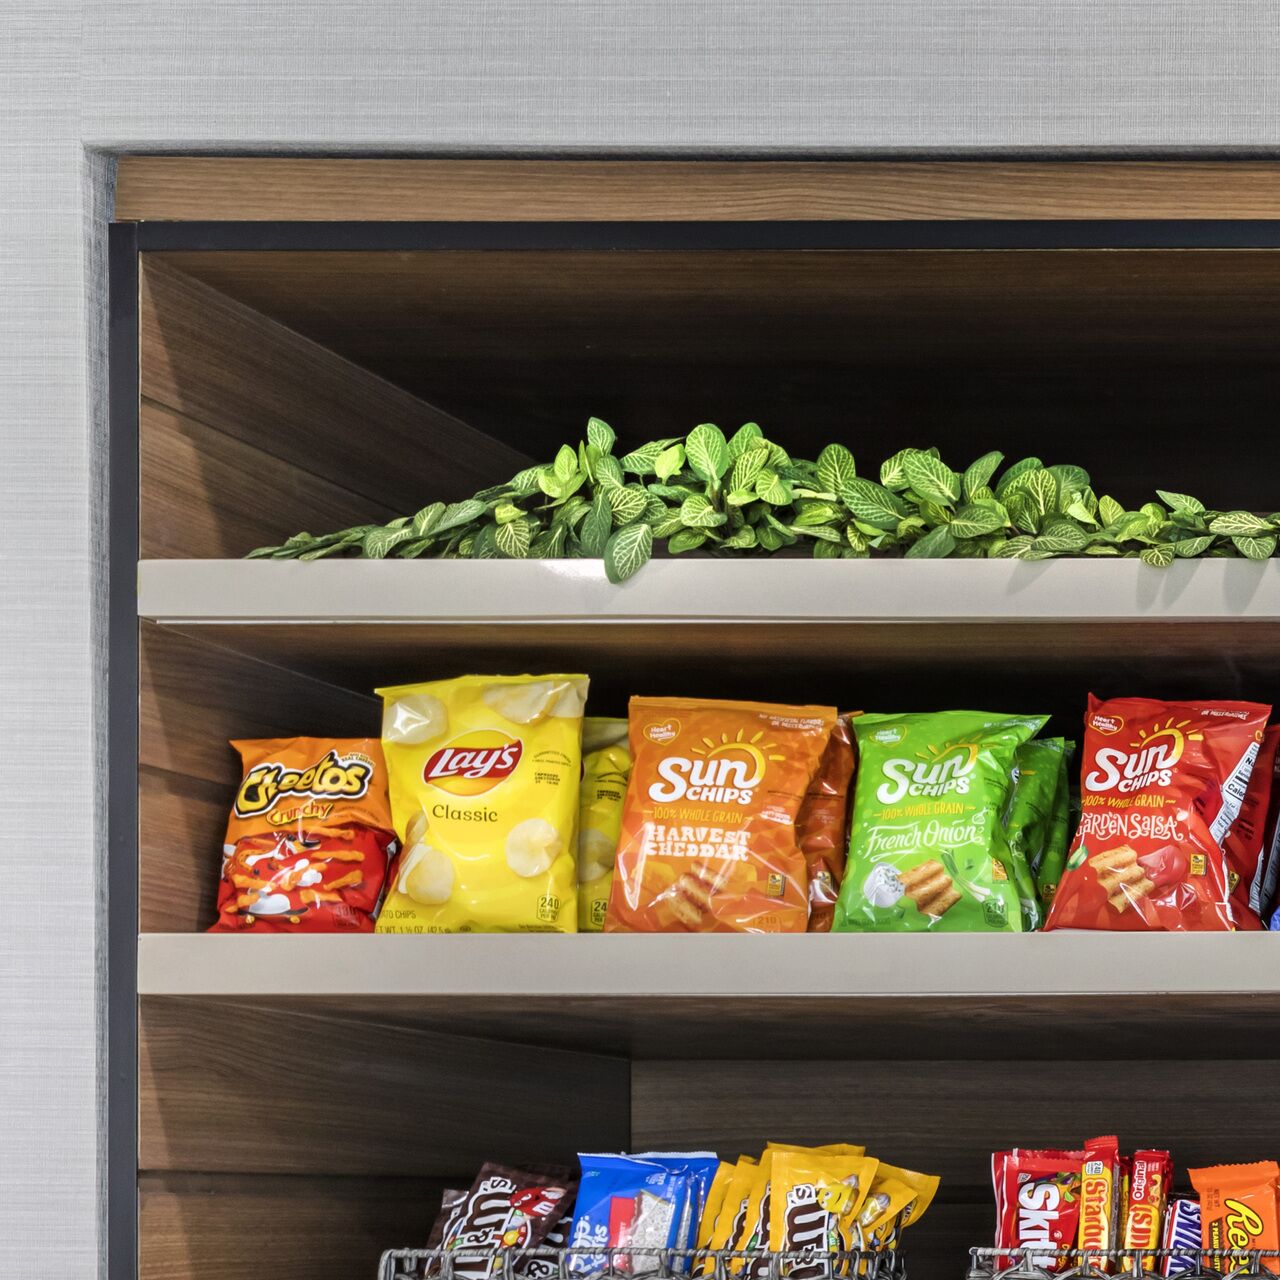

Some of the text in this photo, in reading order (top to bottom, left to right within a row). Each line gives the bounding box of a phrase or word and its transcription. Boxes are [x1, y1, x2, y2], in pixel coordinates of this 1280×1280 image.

[429, 743, 519, 779] Lay's
[1085, 744, 1180, 792] Sun
[235, 751, 372, 816] Cheetos
[649, 757, 757, 802] Sun
[876, 755, 976, 804] Sun
[909, 777, 970, 797] CHIPS
[1119, 769, 1172, 792] CHIPS
[686, 788, 752, 805] CHIPS
[1084, 794, 1164, 808] 100% WHOLE GRAIN
[267, 802, 333, 825] Crunchy
[432, 804, 498, 822] Classic
[654, 807, 743, 823] 100% WHOLE GRAIN
[882, 803, 964, 819] 100% WHOLE GRAIN
[647, 824, 751, 845] HARVEST
[863, 820, 983, 859] French Onion
[645, 840, 749, 861] CHEDDAR
[540, 897, 559, 909] 240
[1133, 1161, 1147, 1200] Original
